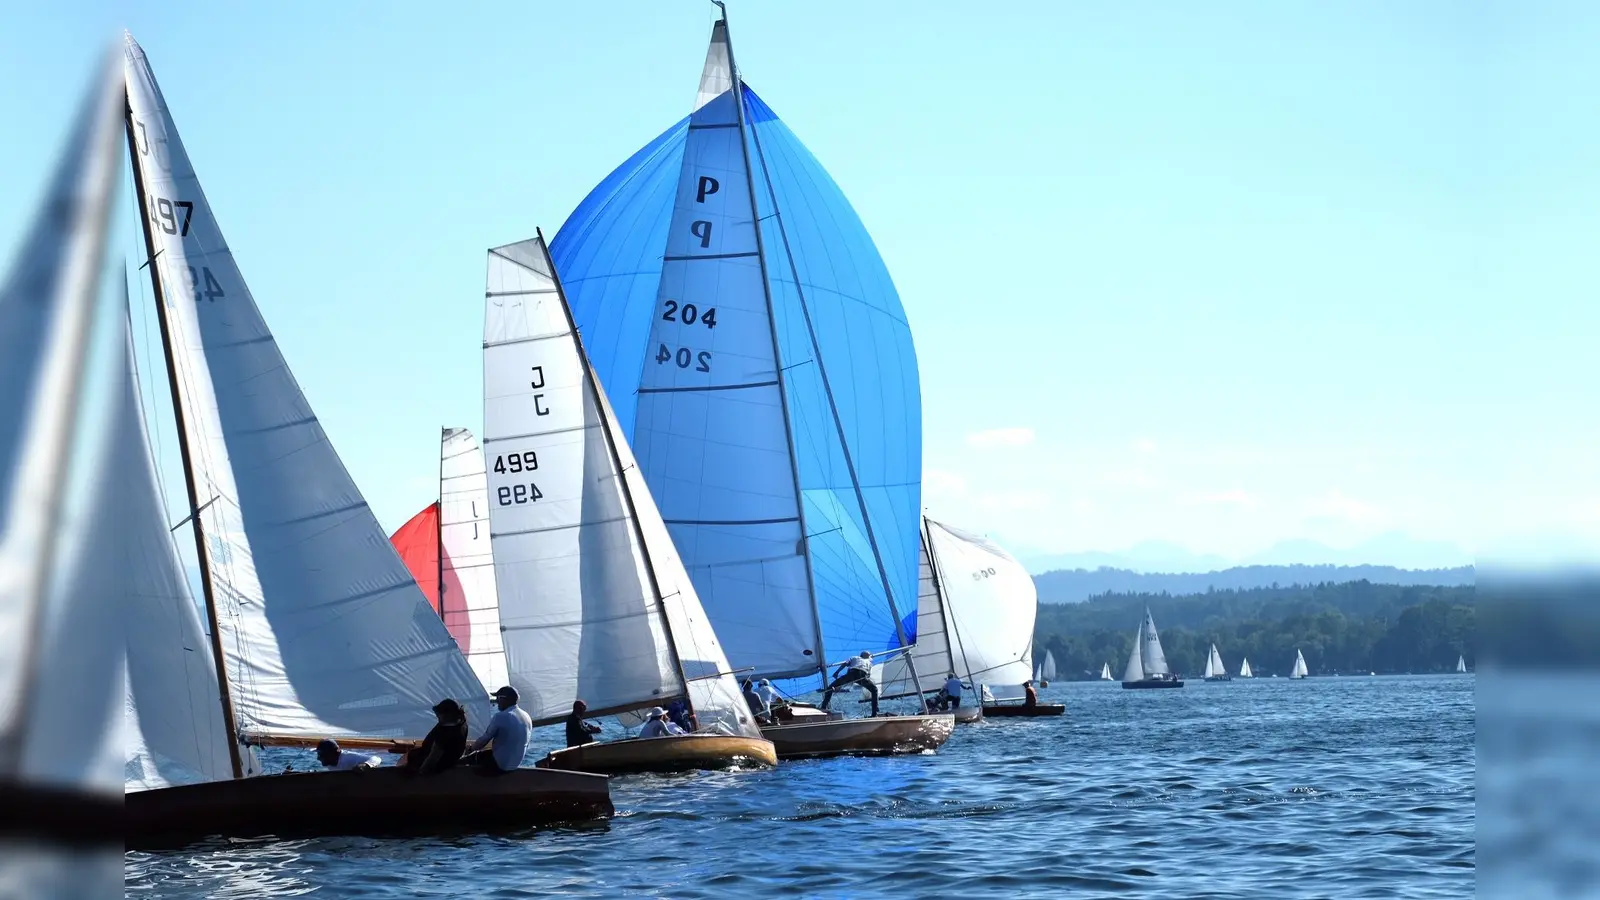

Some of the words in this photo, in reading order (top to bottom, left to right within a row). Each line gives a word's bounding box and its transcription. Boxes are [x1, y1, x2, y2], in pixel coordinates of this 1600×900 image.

[696, 175, 720, 204] P
[150, 194, 194, 237] 497
[662, 300, 717, 330] 204
[531, 365, 545, 390] J
[493, 451, 538, 475] 499
